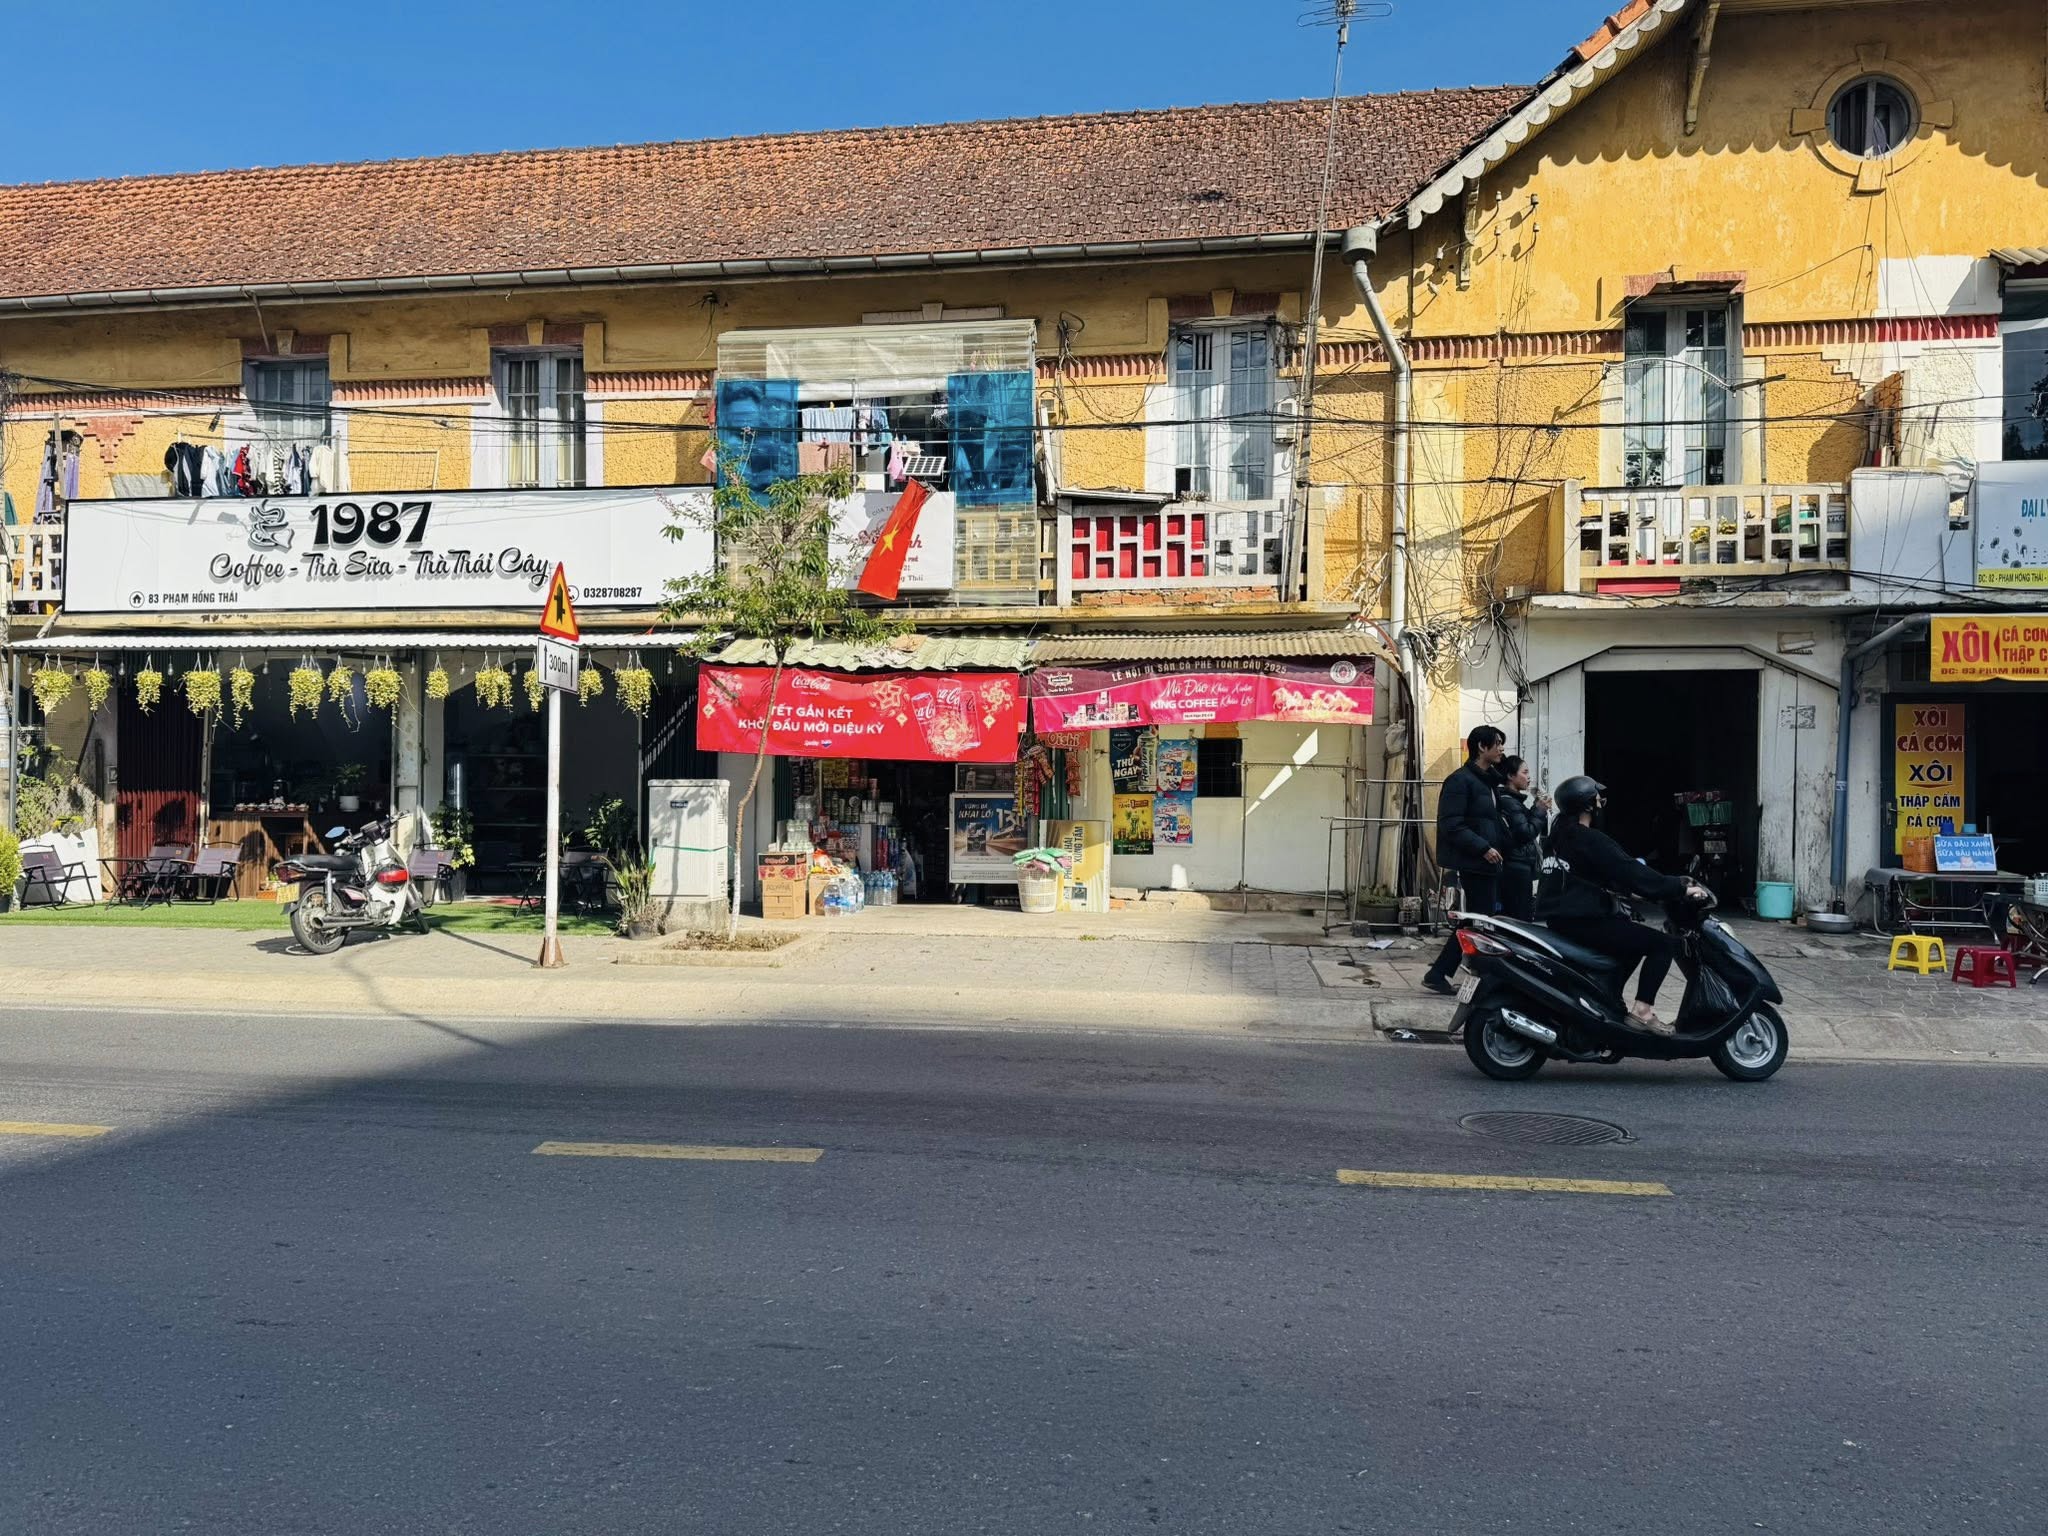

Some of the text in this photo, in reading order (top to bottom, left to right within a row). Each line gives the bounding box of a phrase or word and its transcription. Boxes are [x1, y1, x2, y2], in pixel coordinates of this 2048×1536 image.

[311, 501, 433, 546] 1987
[210, 553, 285, 586] Coffee
[302, 552, 341, 578] Trà
[345, 550, 393, 576] Sữa
[410, 550, 450, 575] Trà
[448, 549, 493, 574] Trái
[498, 547, 549, 586] Cây
[148, 593, 159, 604] 83
[163, 593, 189, 606] PHẠM
[218, 591, 238, 603] THÁI
[583, 586, 642, 599] 0328708287
[2002, 625, 2019, 642] CÁ
[1941, 622, 1990, 663] XÔI
[2002, 645, 2035, 665] THẬP
[549, 654, 568, 674] 300m
[1264, 662, 1287, 674] 2025
[828, 705, 853, 719] KẾT
[1150, 699, 1178, 710] KING
[1178, 698, 1218, 710] COFFEE
[1913, 706, 1948, 727] XÔI
[738, 716, 767, 730] KHỞ
[804, 720, 829, 733] MỚI
[833, 722, 864, 737] DIỆU
[1048, 732, 1081, 748] Oishi
[1897, 731, 1964, 752] CÁ CƠM
[1116, 757, 1134, 769] THỬ
[1908, 759, 1952, 782] XÔI
[1113, 766, 1140, 779] NGAY
[1900, 793, 1930, 811] THẬP
[1907, 813, 1922, 828] CÁ
